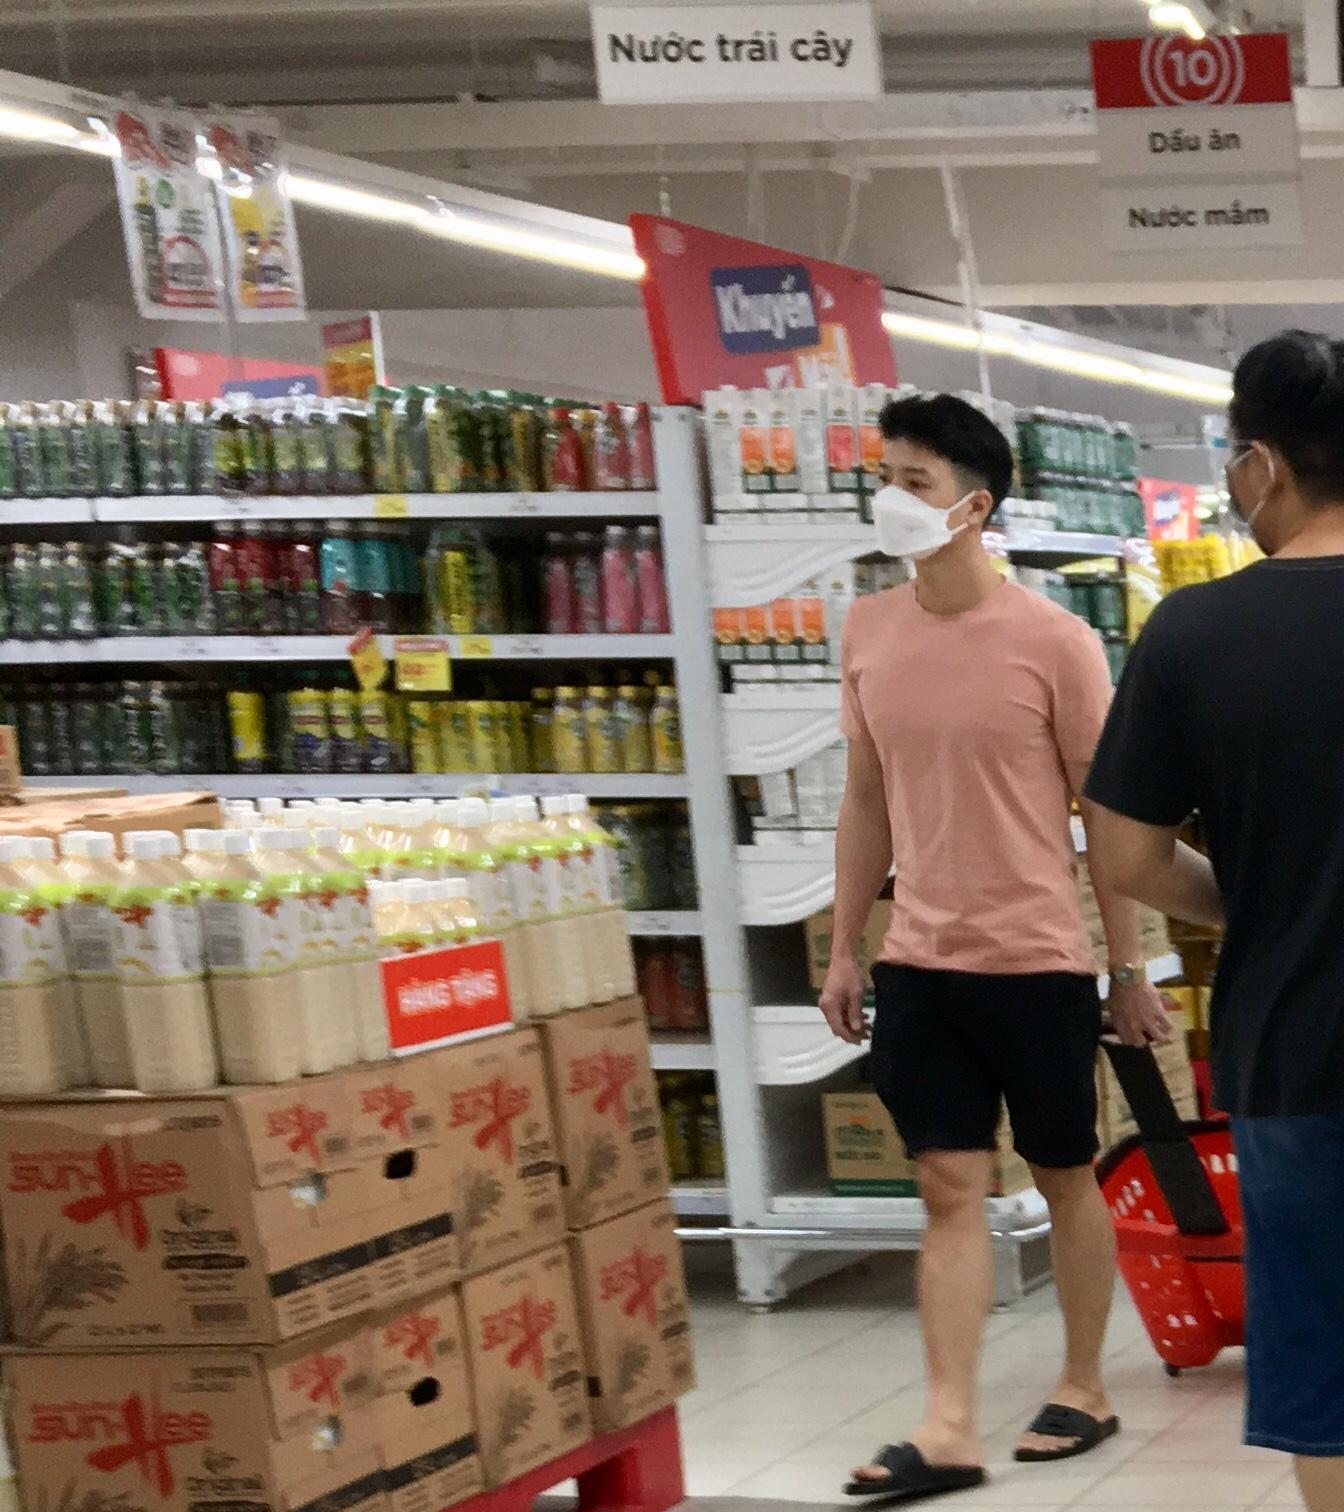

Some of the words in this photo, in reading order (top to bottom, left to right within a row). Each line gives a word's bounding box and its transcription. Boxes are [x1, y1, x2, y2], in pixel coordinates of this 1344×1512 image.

[607, 30, 706, 63] Nước
[715, 29, 779, 63] trái
[789, 29, 854, 67] cây
[1168, 48, 1218, 88] 10
